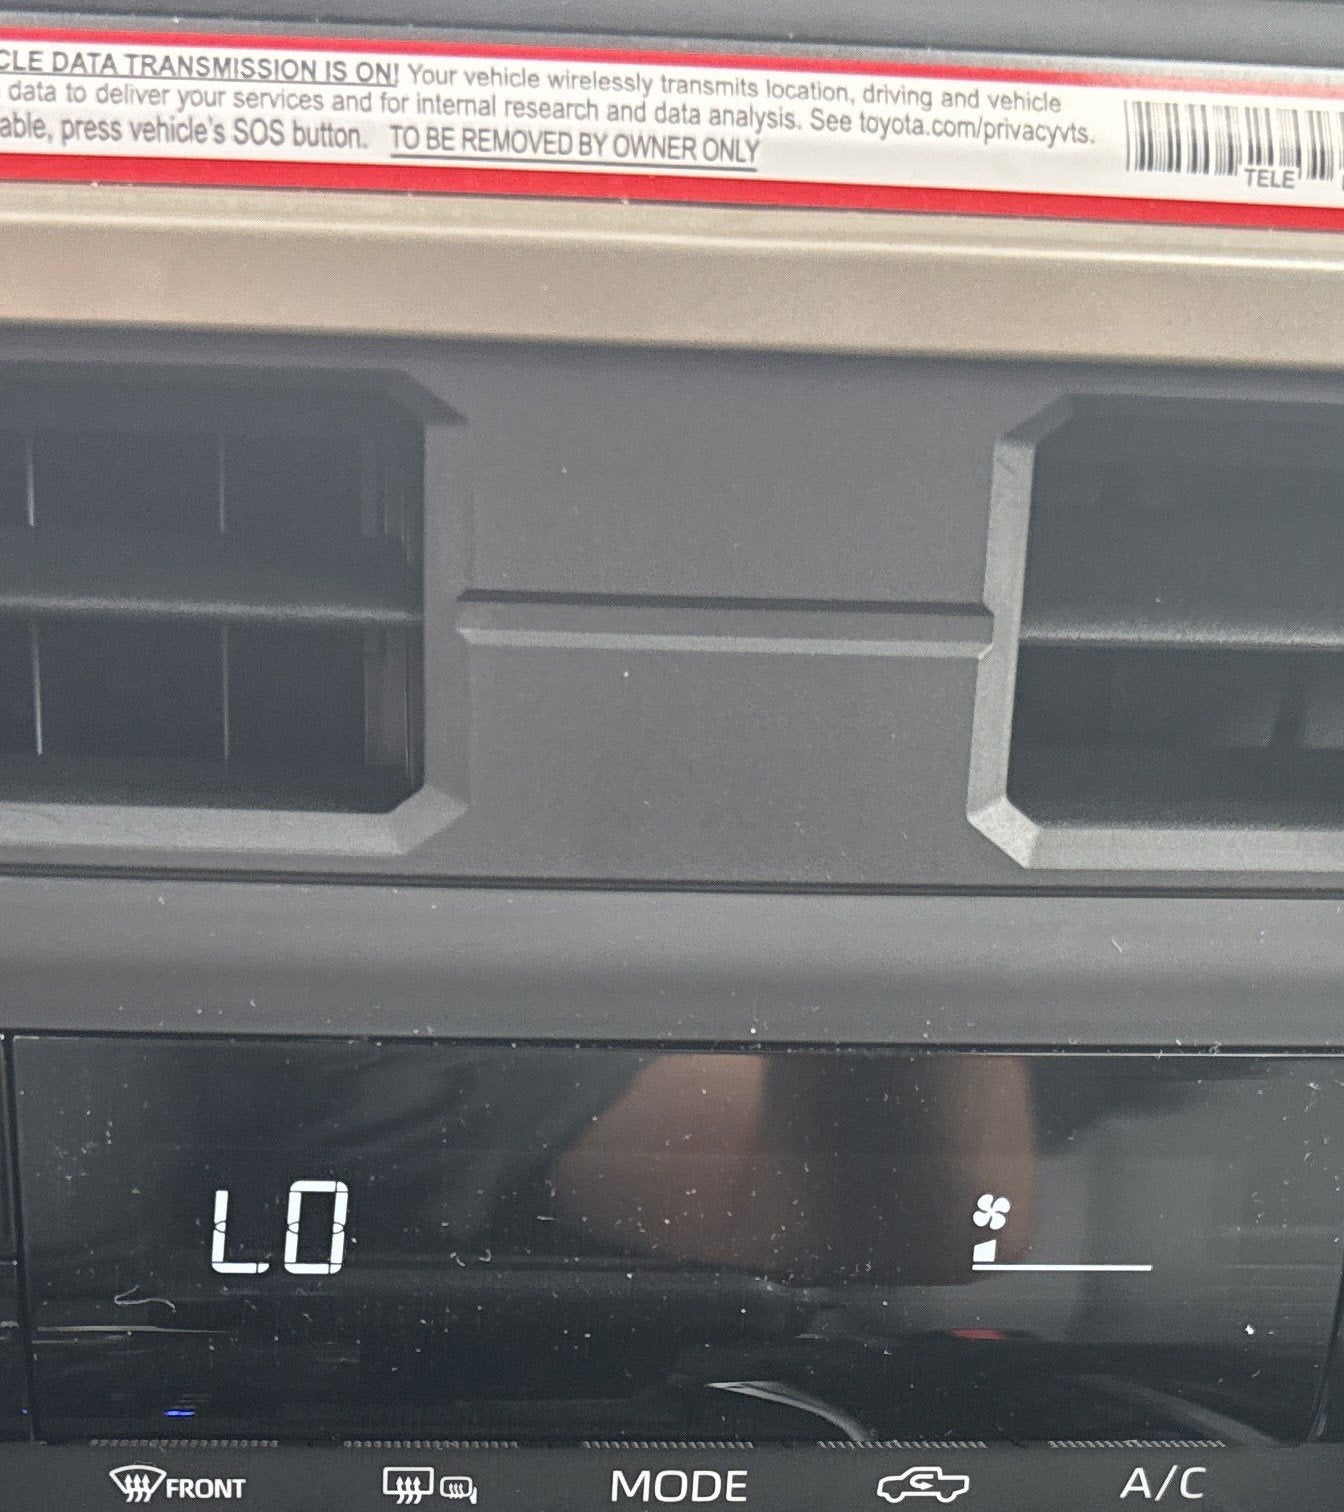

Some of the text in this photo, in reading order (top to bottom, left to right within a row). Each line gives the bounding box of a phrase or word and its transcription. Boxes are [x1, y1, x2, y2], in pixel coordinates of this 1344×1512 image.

[52, 50, 119, 75] DATA
[124, 52, 317, 82] TRANSMISSION
[325, 59, 348, 82] IS
[356, 61, 399, 86] ON!
[407, 62, 458, 86] Your
[464, 66, 540, 90] vehicle
[548, 70, 654, 98] wirelessly
[661, 74, 758, 98] transmits
[766, 78, 855, 105] location,
[863, 83, 933, 112] driving
[941, 89, 980, 109] and
[987, 91, 1062, 114] vehicle
[8, 80, 56, 102] data
[66, 82, 87, 103] to
[95, 83, 171, 106] deliver
[177, 87, 226, 113] your
[232, 88, 325, 111] services
[332, 91, 373, 113] and
[380, 92, 409, 114] for
[416, 92, 497, 118] internal
[504, 96, 599, 121] research
[606, 101, 647, 123] and
[654, 102, 701, 126] data
[709, 104, 802, 134] analysis.
[810, 107, 852, 133] See
[859, 110, 1096, 149] toyota.com/privacyvts.
[61, 115, 123, 147] press
[130, 114, 226, 145] vehicle's
[233, 116, 285, 147] SOS
[293, 118, 369, 150] button.
[390, 124, 421, 150] TO
[426, 126, 455, 151] BE
[462, 128, 574, 157] REMOVED
[579, 132, 608, 157] BY
[613, 134, 697, 161] OWNER
[702, 137, 760, 164] ONLY
[1244, 168, 1296, 189] TELE
[165, 1478, 247, 1499] FRONT
[610, 1469, 749, 1503] MODE
[1119, 1465, 1207, 1501] A/C
